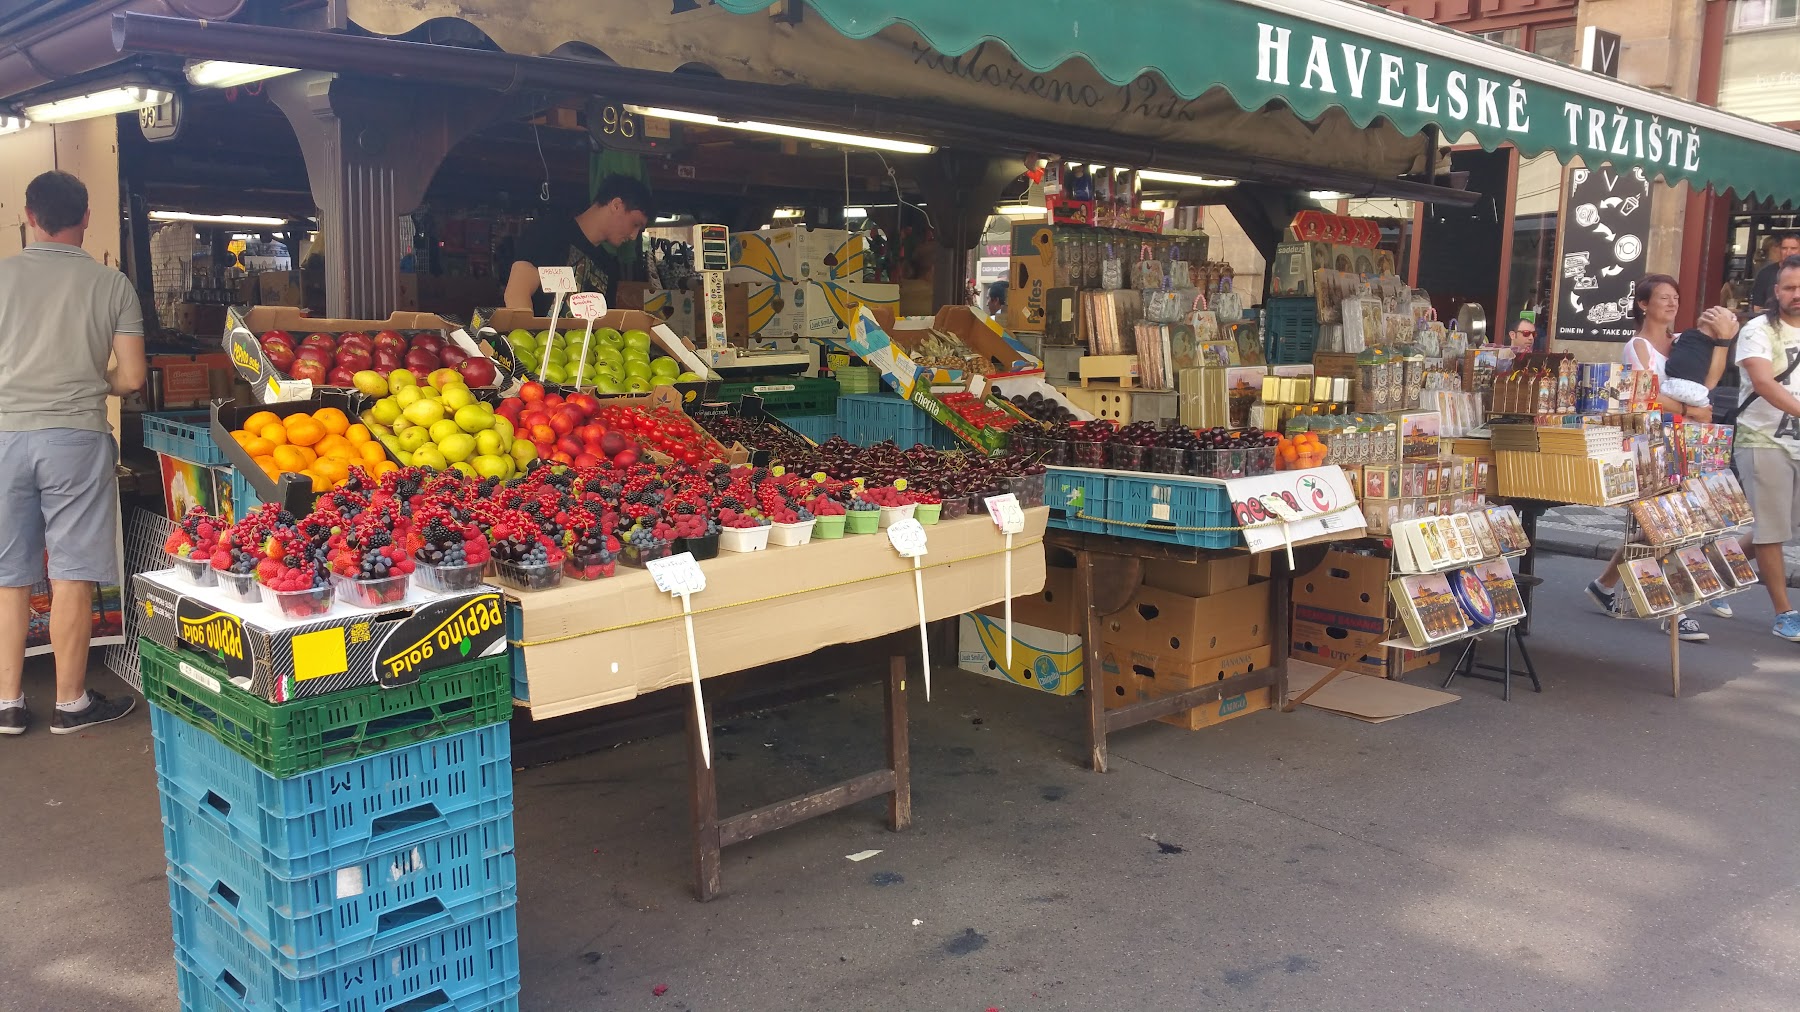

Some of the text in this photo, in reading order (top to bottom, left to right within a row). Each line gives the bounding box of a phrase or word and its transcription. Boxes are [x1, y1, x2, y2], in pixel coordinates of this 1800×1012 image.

[1600, 36, 1616, 73] V
[1256, 22, 1701, 172] HAVELSKÉ TRŽIŠTĚ
[602, 106, 635, 138] 96
[1603, 169, 1619, 192] V
[1602, 328, 1621, 336] TAKE
[914, 390, 940, 416] cherita
[183, 618, 244, 660] pepino gold
[390, 599, 503, 678] pepino gold
[1221, 655, 1252, 669] BANANAS
[1221, 699, 1247, 715] AMIGO
